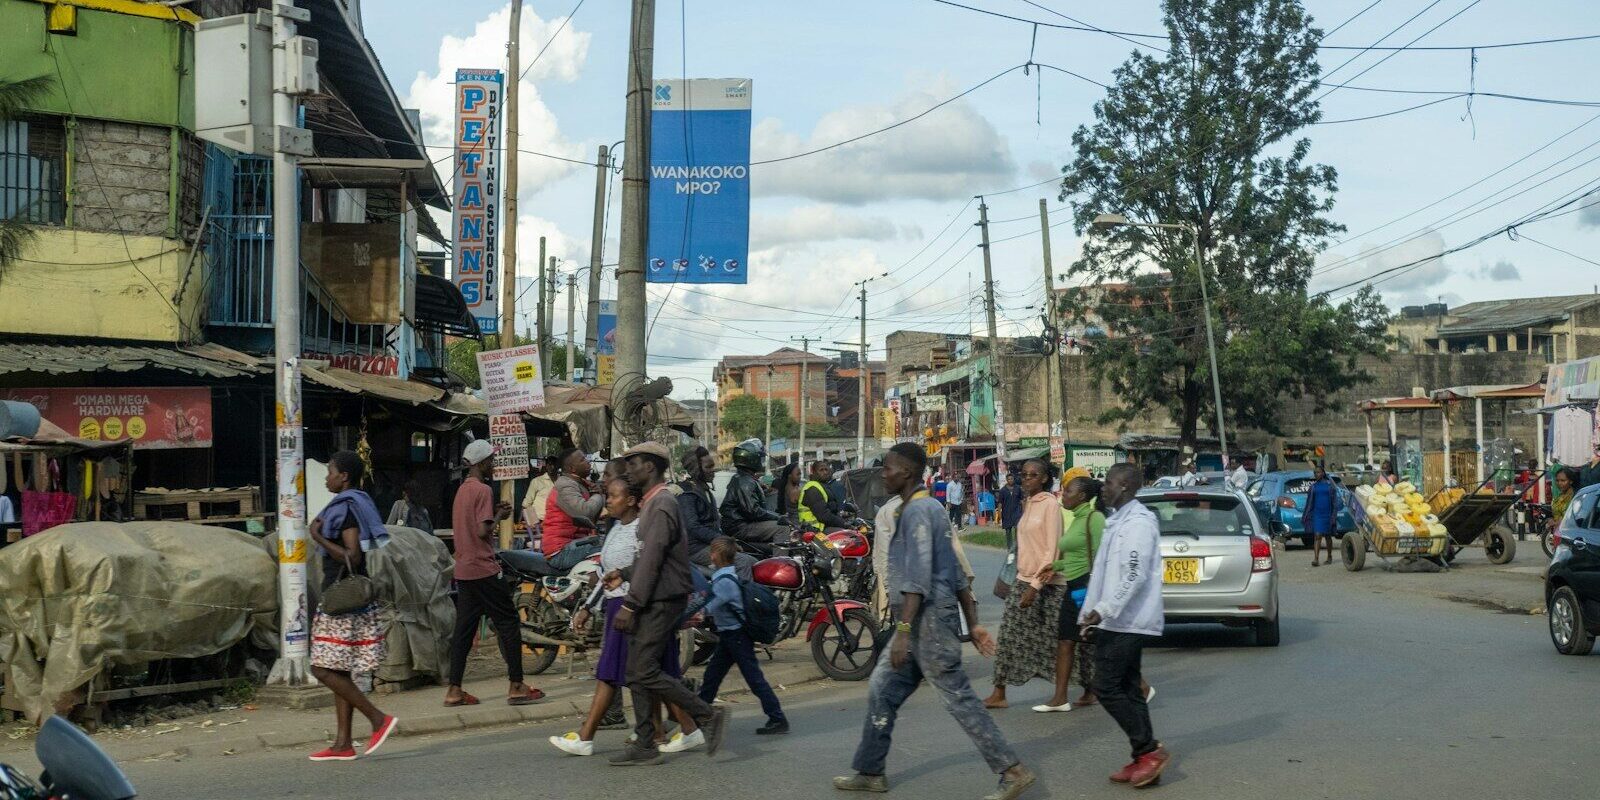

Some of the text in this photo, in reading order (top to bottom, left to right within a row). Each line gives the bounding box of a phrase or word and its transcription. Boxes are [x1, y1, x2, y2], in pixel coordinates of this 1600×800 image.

[651, 166, 747, 179] WANAKOKO
[676, 181, 721, 195] MPO?
[459, 84, 487, 307] PETANNS
[485, 89, 497, 301] DRIVING SCHOOL
[480, 346, 537, 362] MUSIC CLASSES
[486, 369, 506, 377] GUITAR
[488, 384, 509, 392] VOCALS
[73, 395, 150, 405] JOMARI MEGA
[79, 405, 145, 416] HARDWARE
[1169, 571, 1197, 582] 195Y
